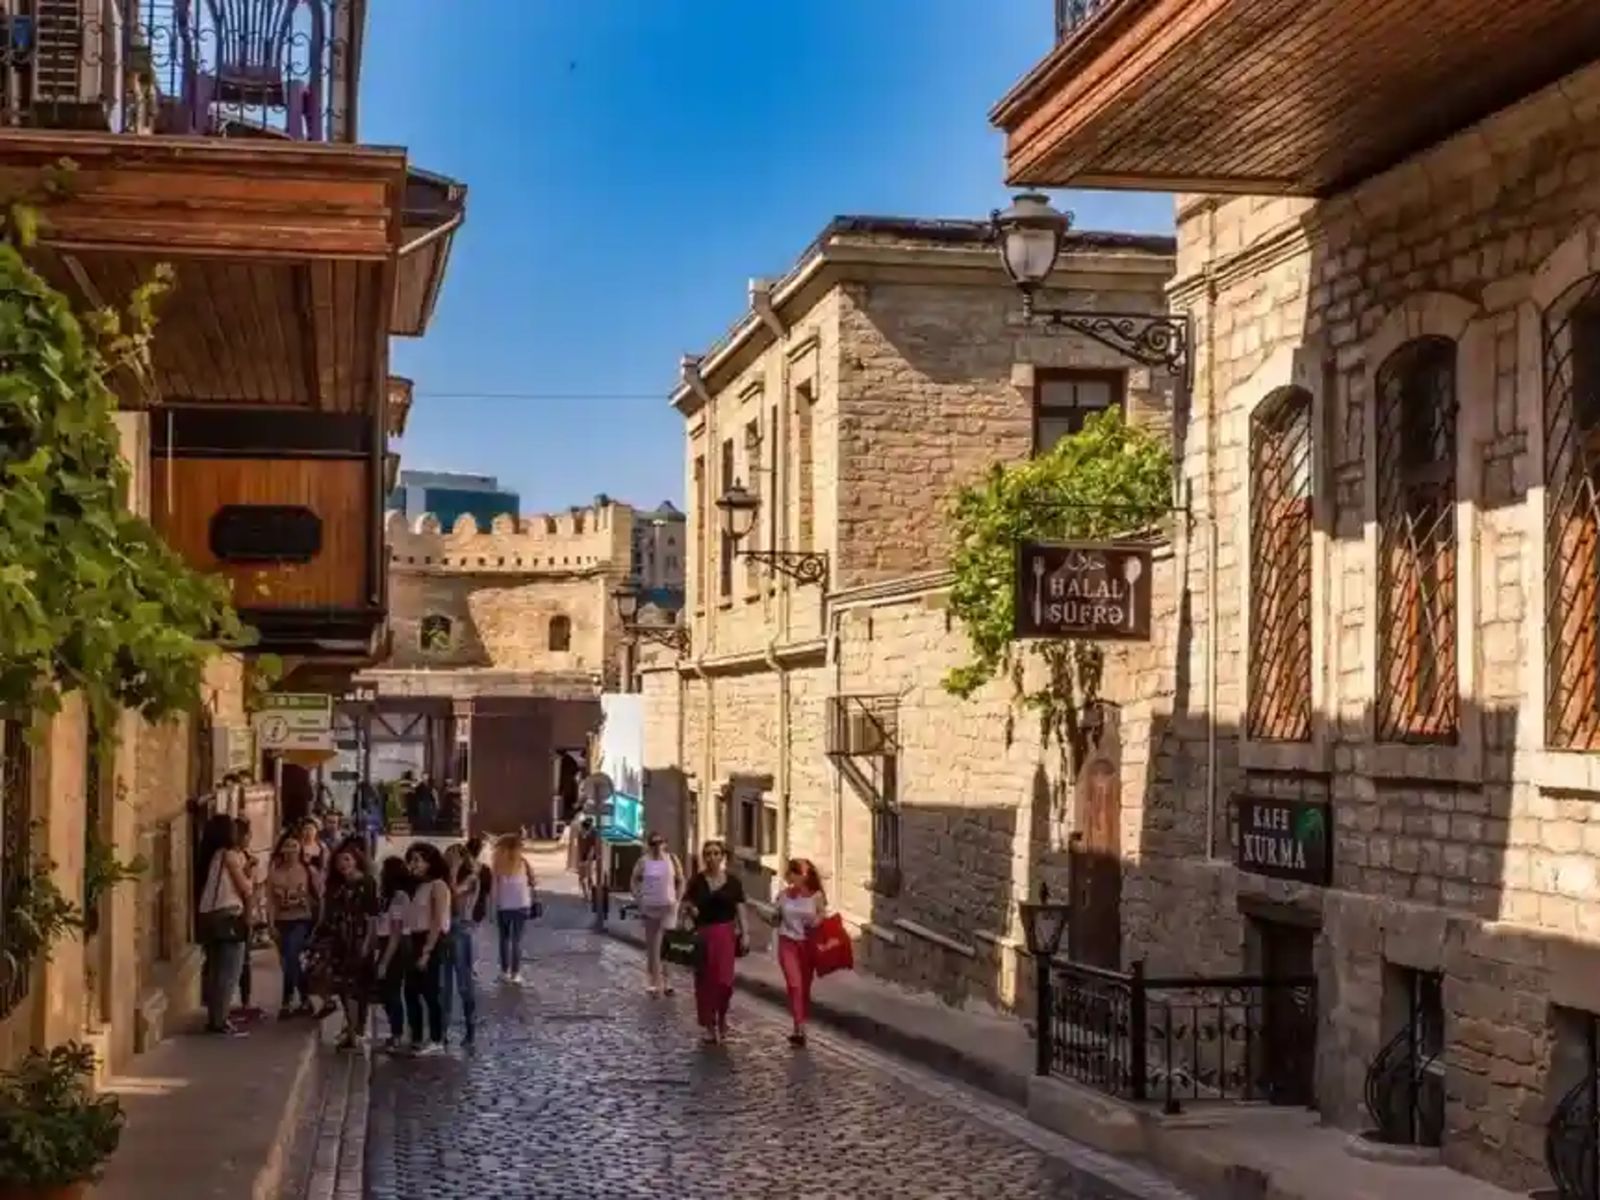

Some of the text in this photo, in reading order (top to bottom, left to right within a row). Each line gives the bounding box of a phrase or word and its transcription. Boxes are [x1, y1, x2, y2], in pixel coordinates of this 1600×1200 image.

[1050, 577, 1124, 598] HALAL
[1253, 805, 1290, 831] KAFE
[1243, 834, 1306, 869] XURMA
